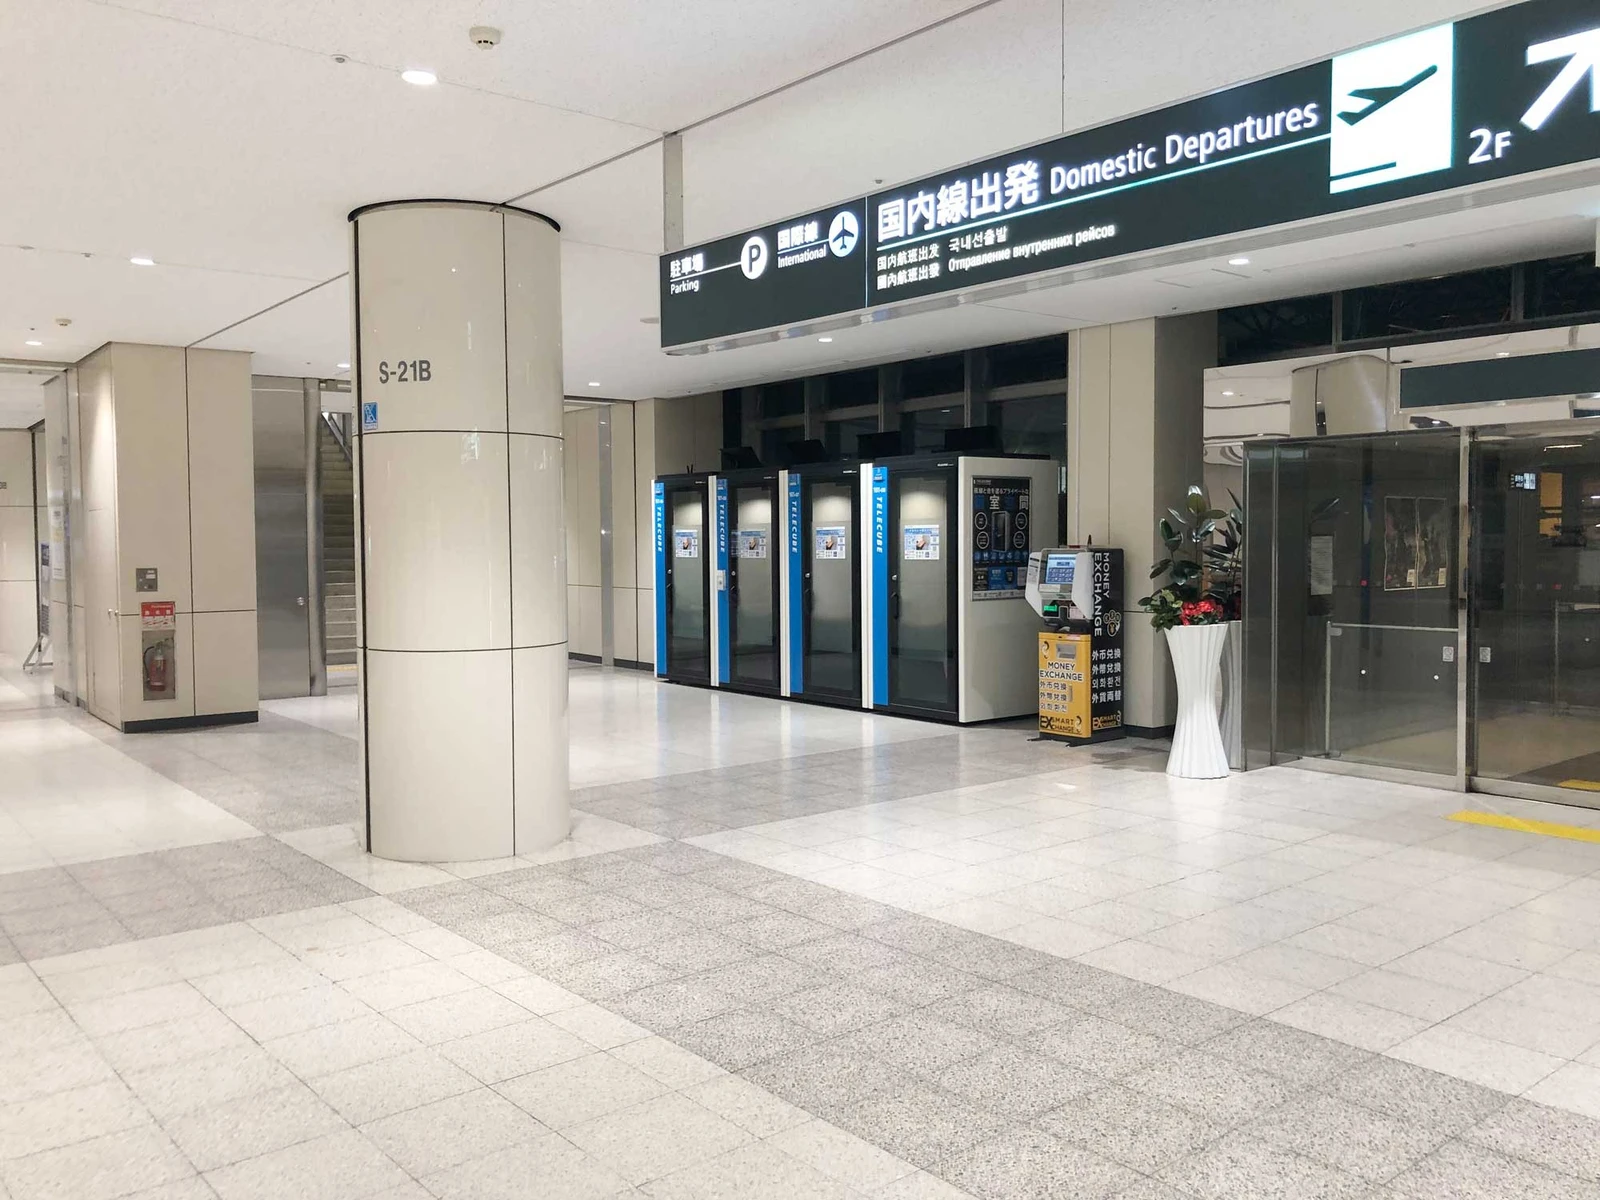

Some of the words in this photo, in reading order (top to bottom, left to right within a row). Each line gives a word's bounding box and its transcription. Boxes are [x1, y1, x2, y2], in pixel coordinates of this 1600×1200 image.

[1050, 143, 1156, 195] Domestic
[1165, 101, 1319, 165] Departures
[1468, 127, 1512, 165] 2F
[877, 160, 1039, 243] 国内線出発
[777, 221, 818, 250] 国際線
[948, 225, 1008, 252] 국내선출발
[948, 248, 1011, 272] Отправление
[1012, 234, 1073, 258] внутренних
[1075, 224, 1116, 246] рейсов
[777, 245, 827, 268] International
[877, 243, 940, 271] 国内航班出发
[670, 280, 700, 295] Parking
[379, 360, 432, 384] S-21B
[1094, 552, 1102, 636] EXCHANGE
[1040, 670, 1083, 681] EXCHANGE
[1048, 662, 1075, 670] MONEY
